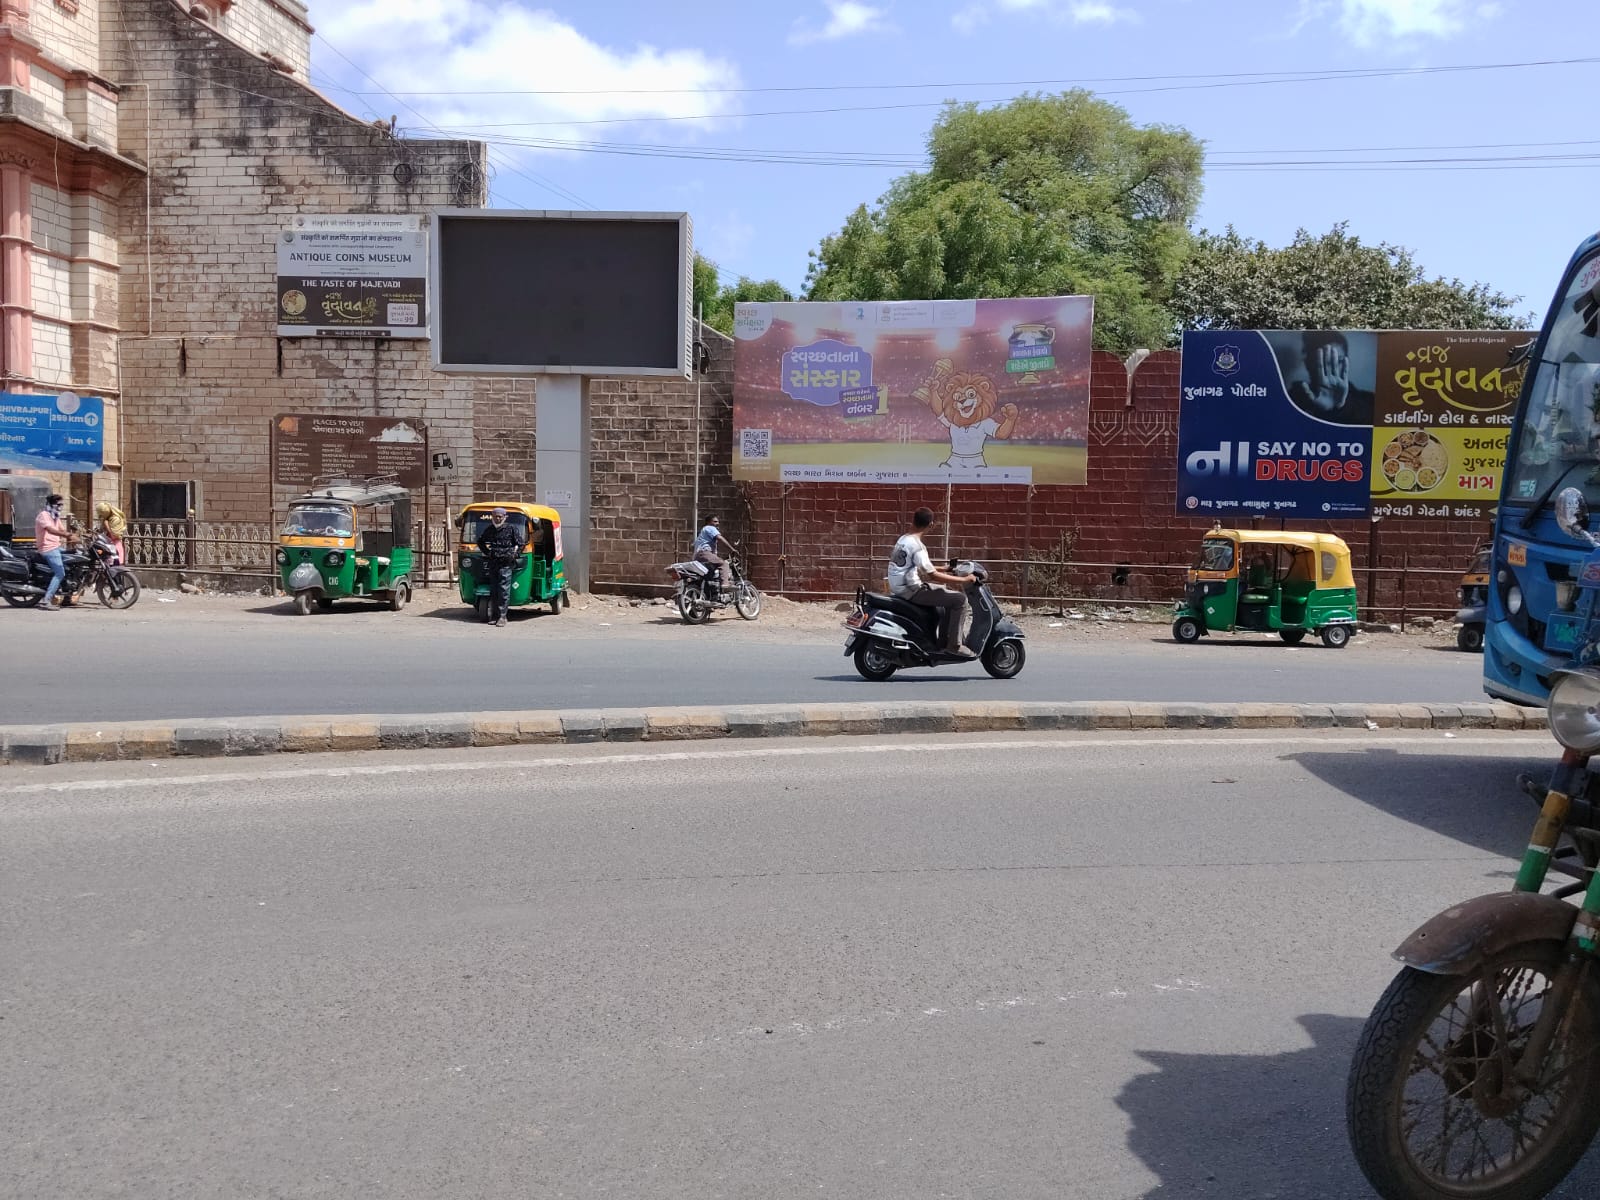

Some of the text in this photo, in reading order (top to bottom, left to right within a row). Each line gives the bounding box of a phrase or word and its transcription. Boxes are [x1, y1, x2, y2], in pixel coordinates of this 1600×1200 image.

[289, 252, 412, 263] ANTIQUE COINS MUSEUM
[301, 279, 401, 288] THE TASTE OF MAJEVADI
[790, 351, 859, 363] સ્વચ્છતાના
[1417, 345, 1451, 363] વ્રજ
[789, 363, 861, 388] સંસ્કાર
[1183, 383, 1267, 401] જુનાગઢ પોલીસ
[847, 403, 873, 414] નંબર
[1438, 409, 1464, 424] હોલ
[1469, 414, 1479, 424] &
[1257, 441, 1364, 457] SAY NO TO
[1185, 441, 1250, 477] ના
[1255, 459, 1363, 482] DRUGS
[1458, 474, 1494, 490] માત્ર
[1373, 503, 1481, 517] મજેવડી ગેટની અંદર
